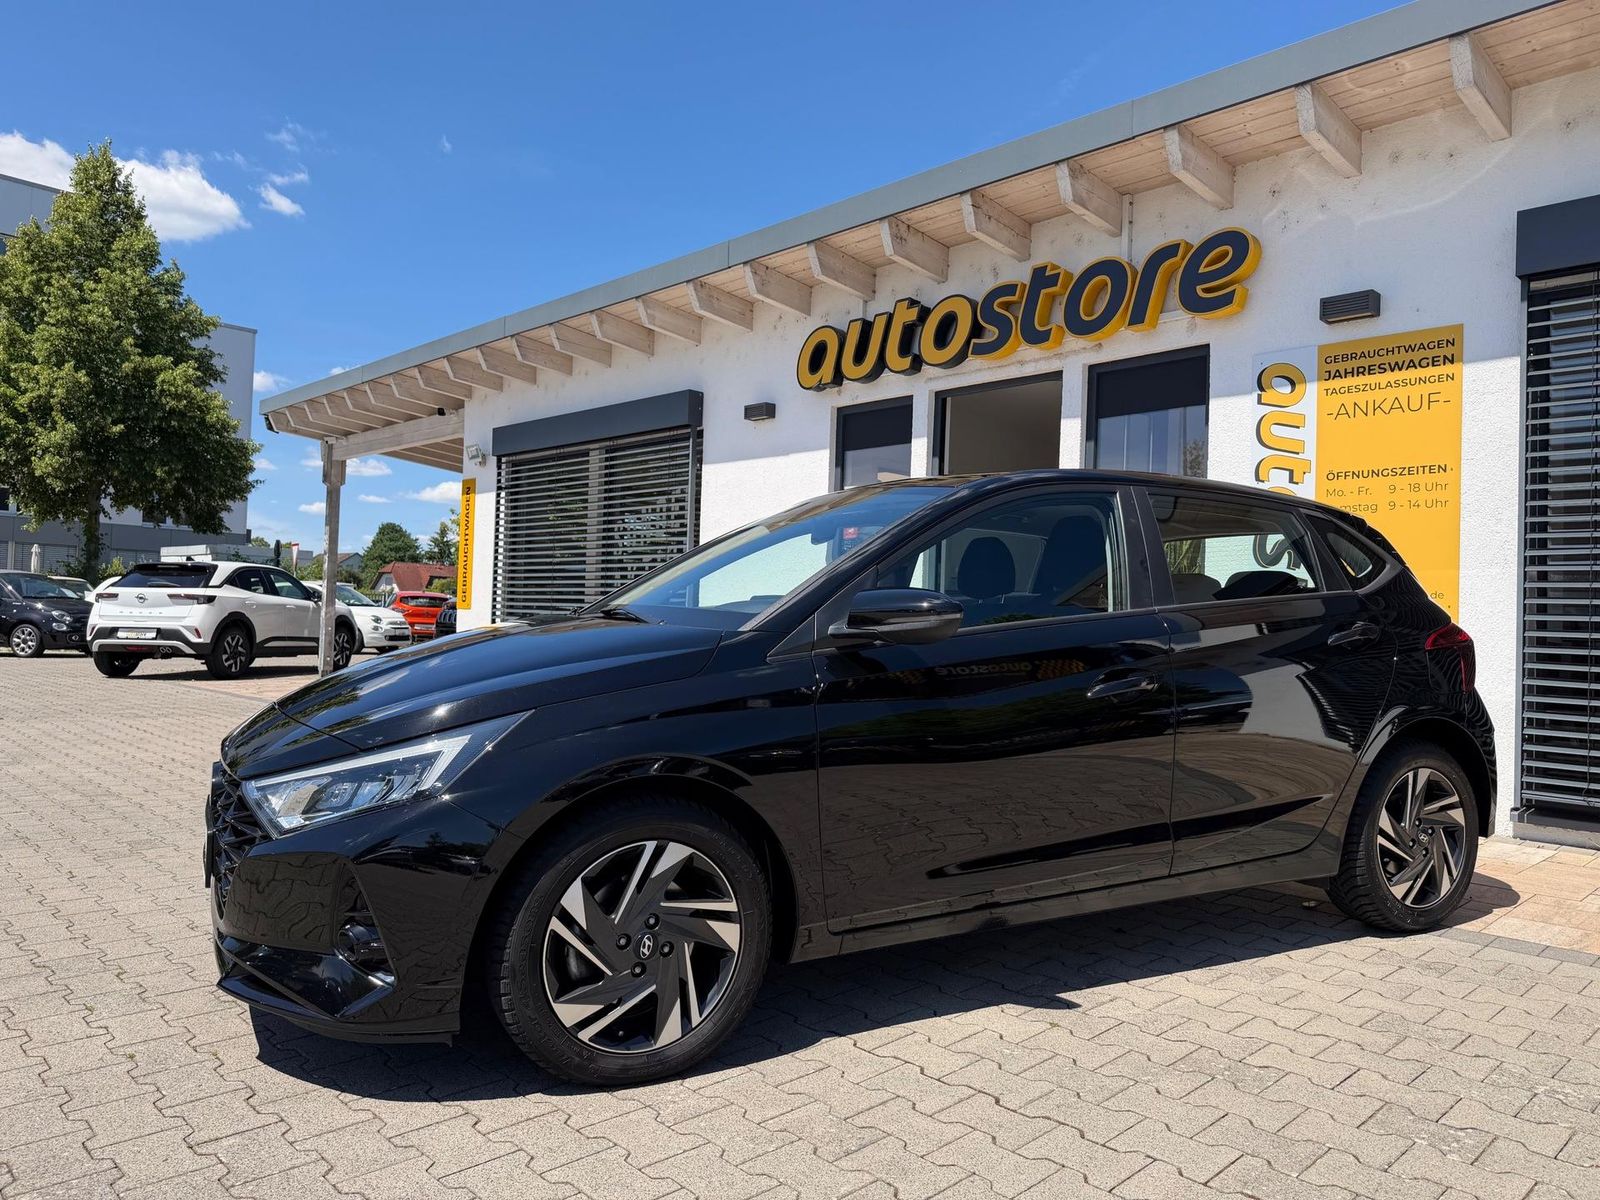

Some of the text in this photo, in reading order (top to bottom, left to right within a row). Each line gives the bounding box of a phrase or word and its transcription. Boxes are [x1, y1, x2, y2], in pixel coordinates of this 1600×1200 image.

[797, 226, 1262, 391] autostore
[1324, 338, 1455, 364] GEBRAUCHTWAGEN
[1324, 353, 1455, 381] JAHRESWAGEN
[1324, 373, 1455, 396] TAGESZULASSUNGEN
[1327, 391, 1451, 420] -ANKAUF-
[1326, 464, 1447, 481] ÖFFNUNGSZEITEN
[1326, 488, 1346, 498] Mo.
[1357, 486, 1372, 496] Fr.
[1388, 484, 1397, 494] 9
[1408, 483, 1421, 493] 18
[1425, 481, 1449, 492] Uhr
[1339, 502, 1378, 514] mstag
[1388, 501, 1397, 510] 9
[1408, 500, 1421, 510] 14
[1425, 498, 1449, 509] Uhr
[461, 486, 471, 603] GEBRAUCHTWAGEN
